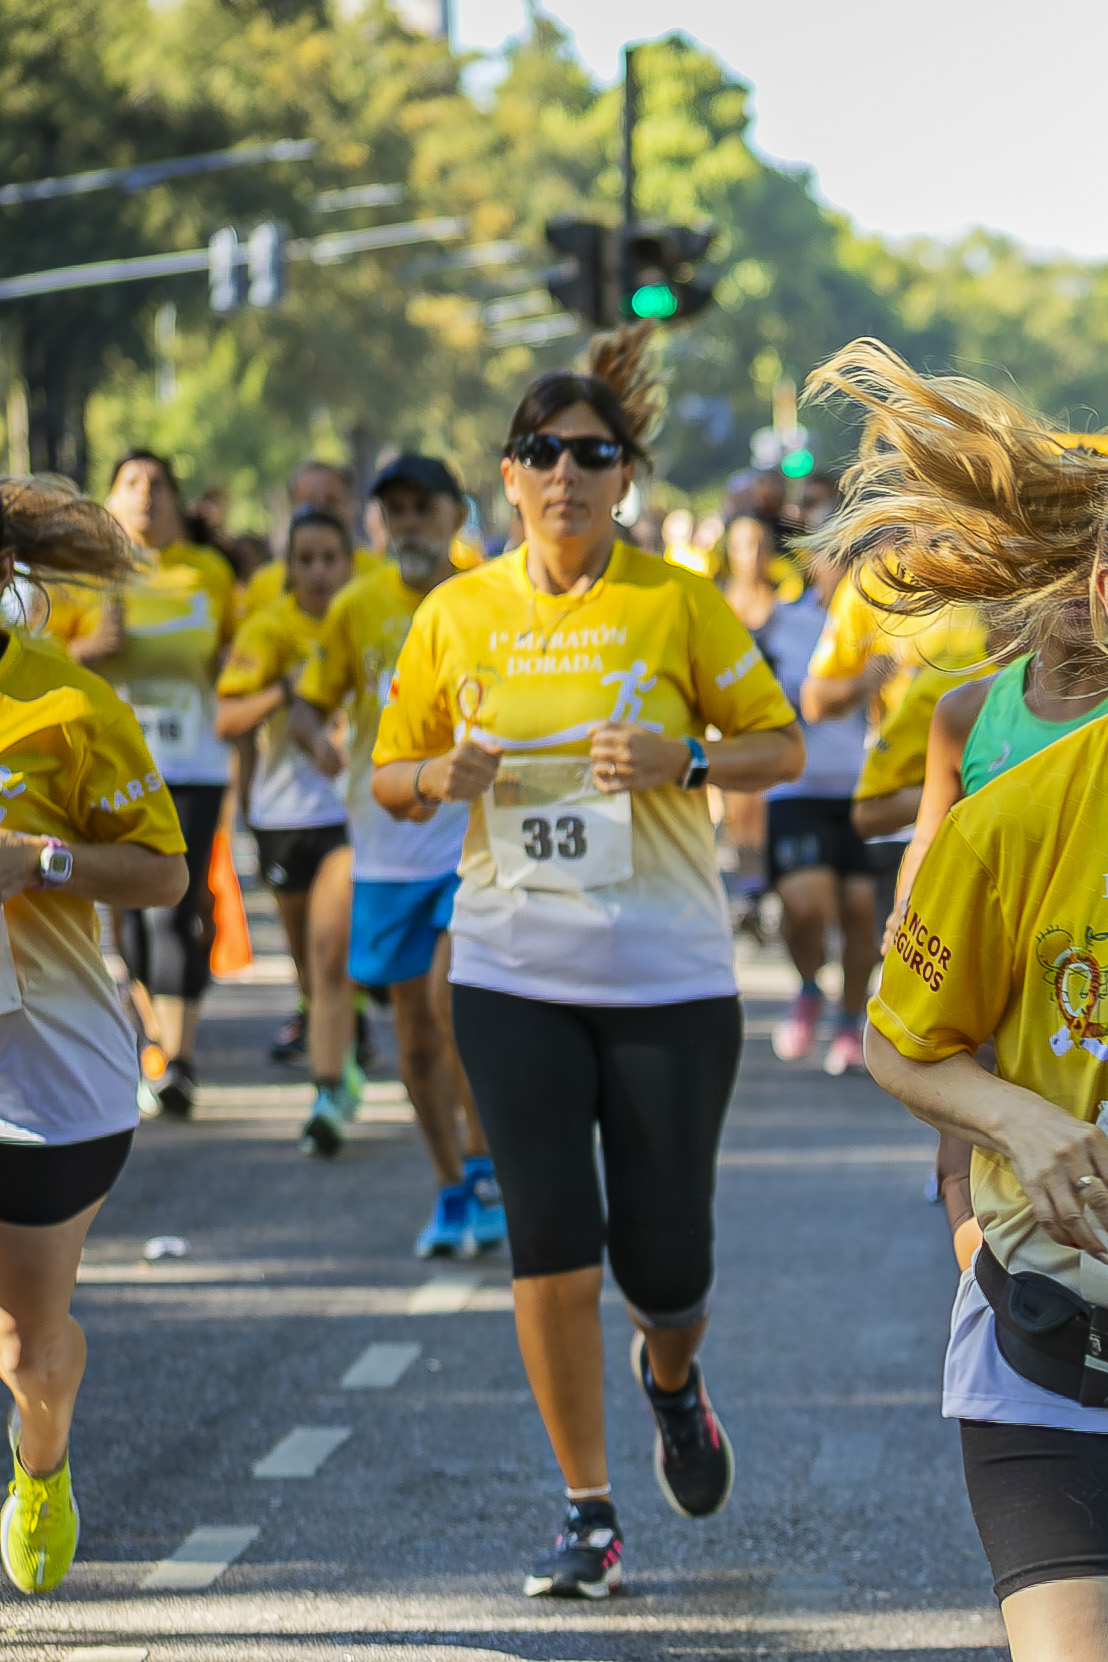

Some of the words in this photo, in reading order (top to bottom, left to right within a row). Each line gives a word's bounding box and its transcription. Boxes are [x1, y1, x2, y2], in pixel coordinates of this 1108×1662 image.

[514, 622, 627, 650] MARATÓN
[507, 653, 603, 676] DORADA
[522, 817, 588, 860] 33
